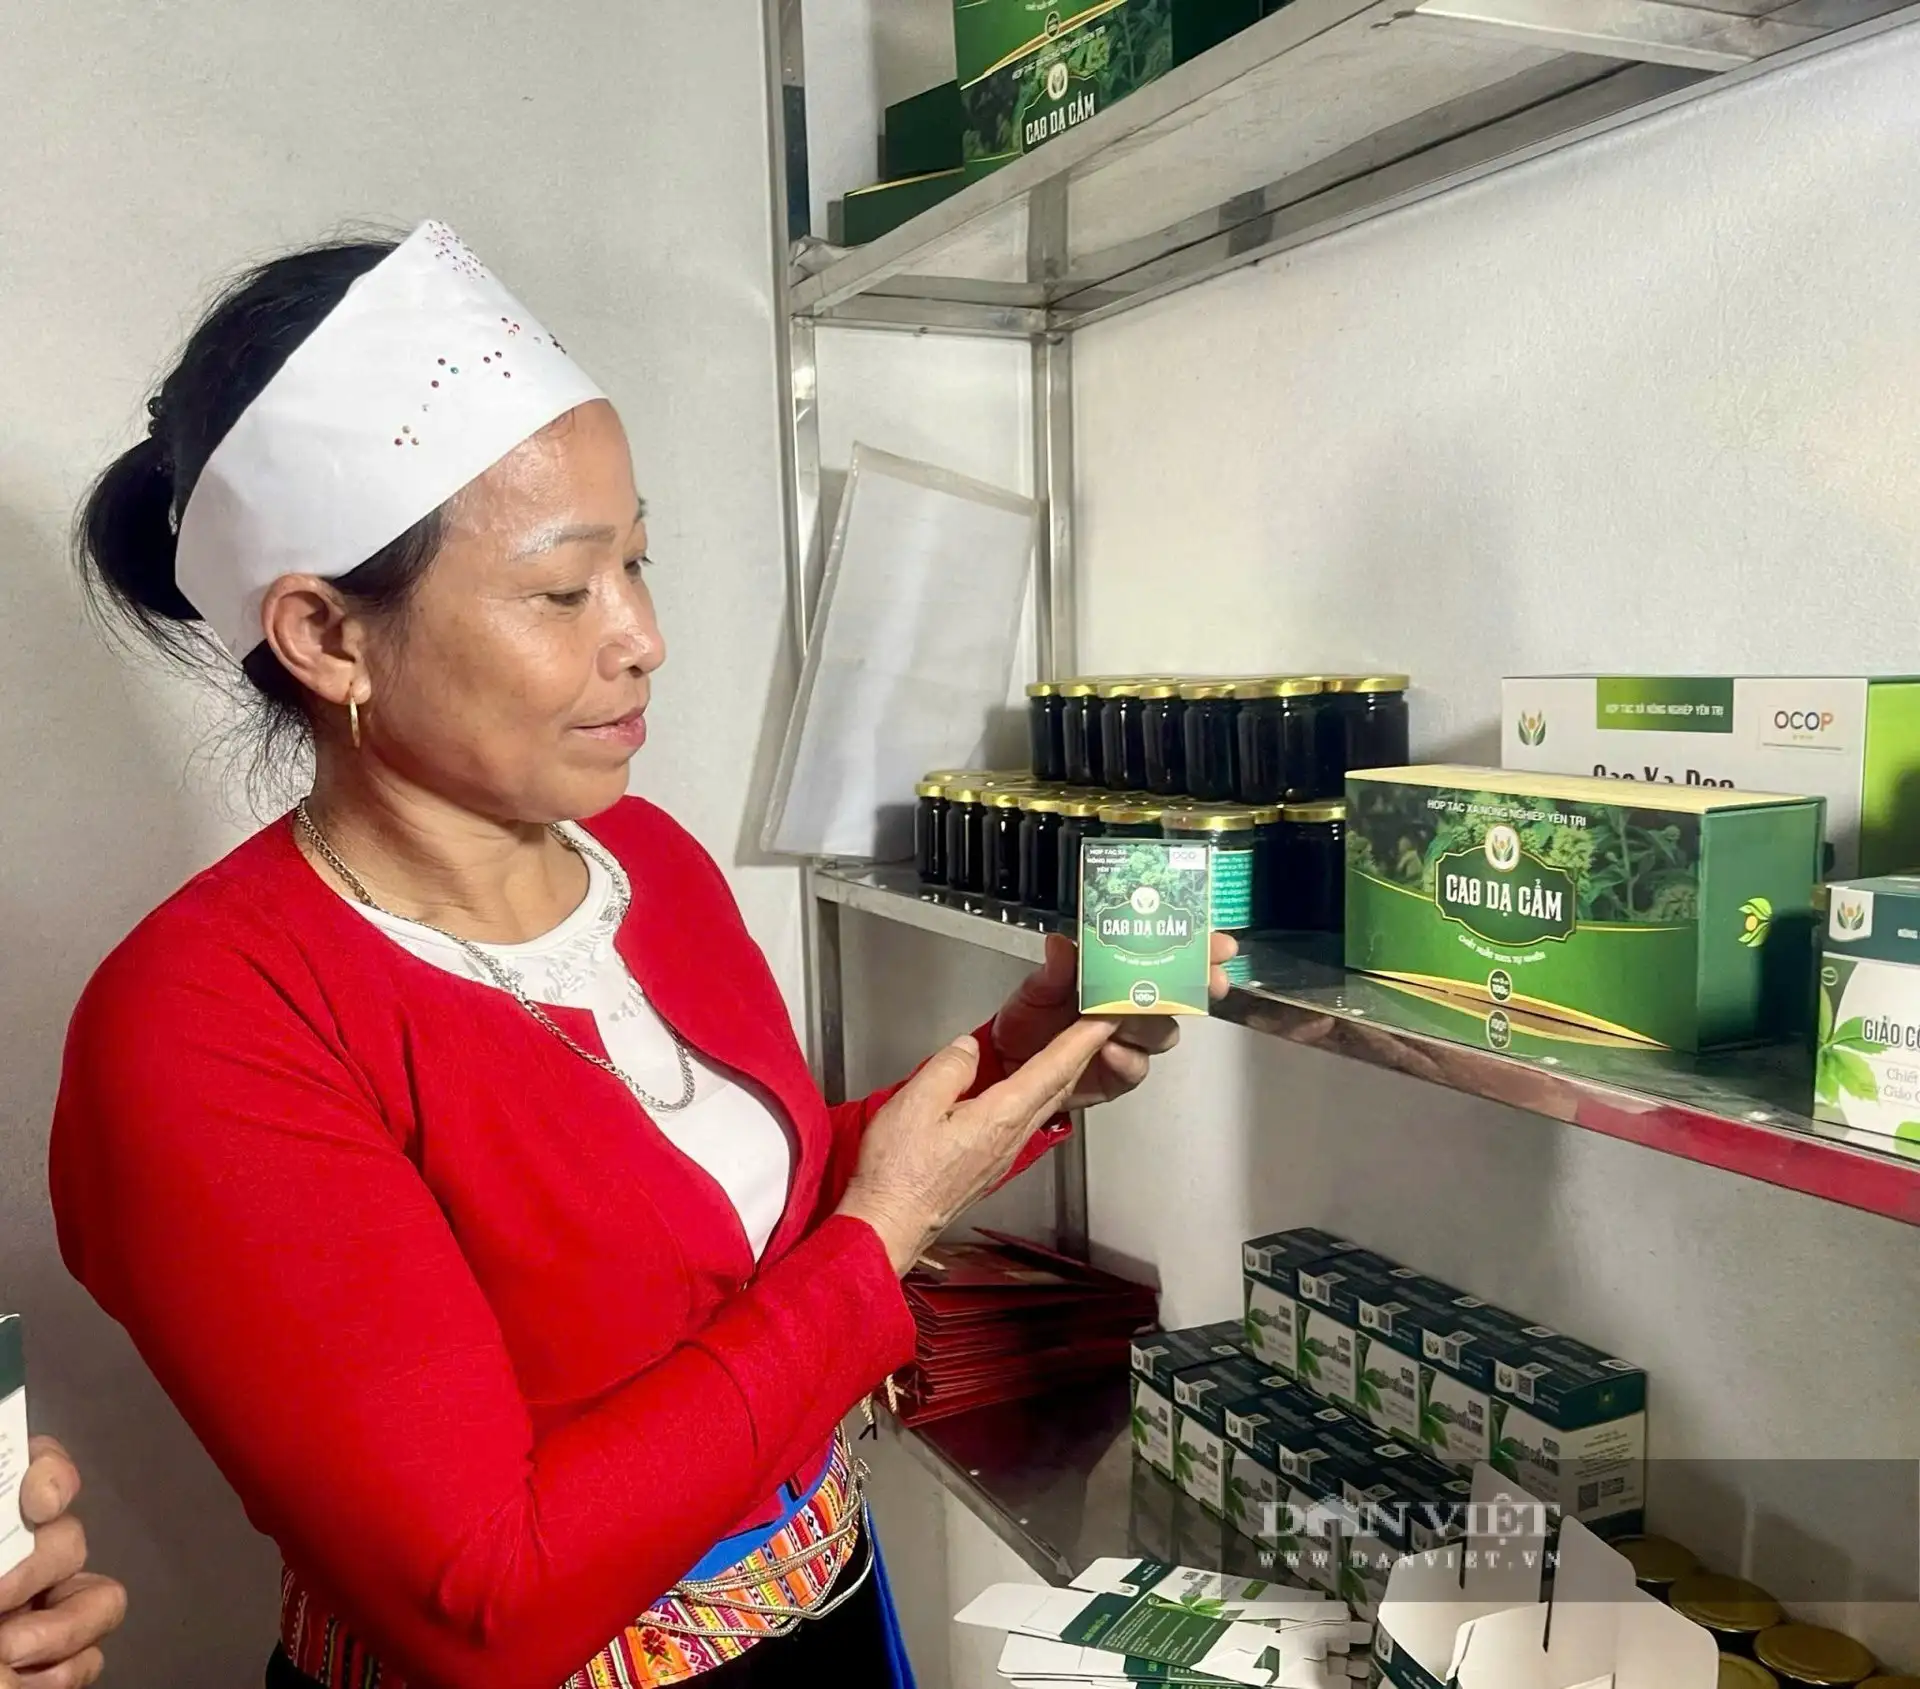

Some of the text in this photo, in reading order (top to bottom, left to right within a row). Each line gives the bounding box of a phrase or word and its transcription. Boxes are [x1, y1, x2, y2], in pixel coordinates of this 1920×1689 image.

[1025, 116, 1048, 145] CAO
[1774, 710, 1834, 732] OCOP
[1446, 874, 1563, 922] CAO DẠ CẨM
[1102, 919, 1130, 936] CAO
[1133, 919, 1153, 939] DẠ
[1864, 1015, 1900, 1045] GIẢO
